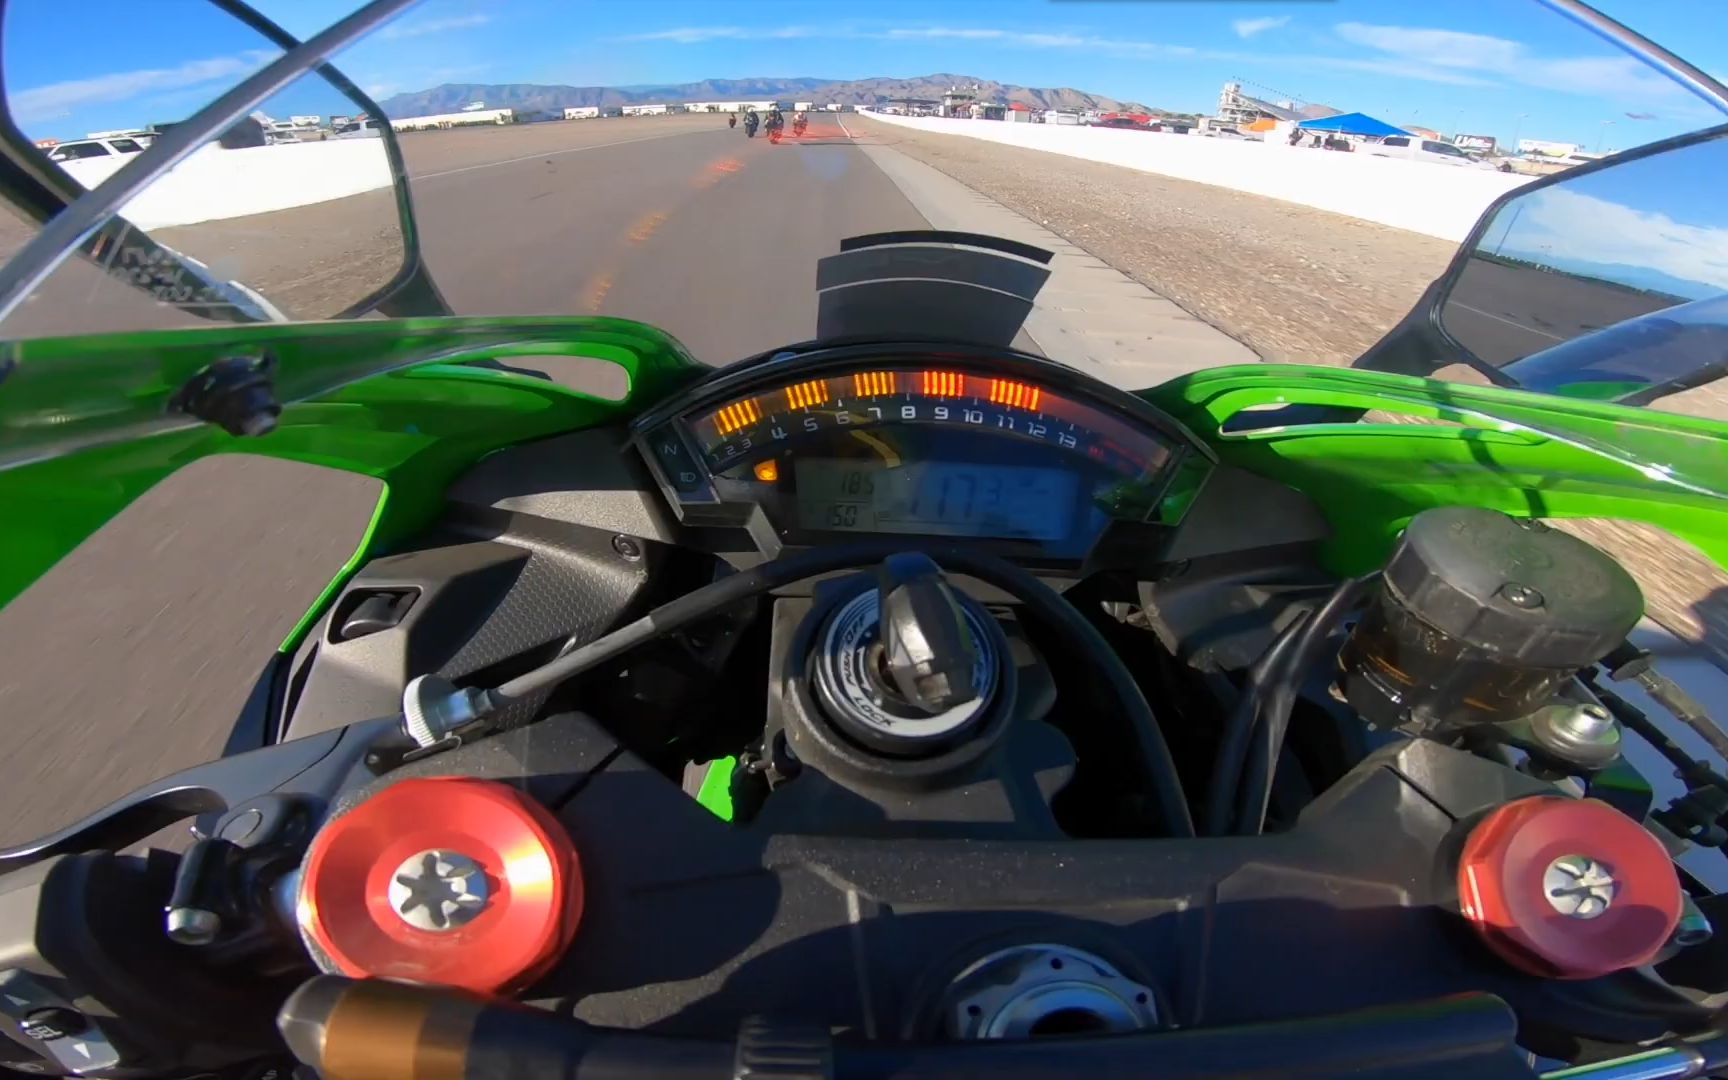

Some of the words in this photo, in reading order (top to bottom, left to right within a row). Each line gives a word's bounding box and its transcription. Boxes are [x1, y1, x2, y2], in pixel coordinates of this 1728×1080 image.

[725, 444, 736, 456] 2
[742, 438, 752, 449] 3
[771, 426, 788, 440] 4
[803, 417, 818, 432] 5
[835, 410, 849, 425] 6
[867, 407, 882, 420] 7
[901, 405, 916, 420] 8
[934, 406, 949, 420] 9
[962, 408, 984, 424] 10
[996, 413, 1015, 429] 11
[1027, 421, 1047, 439] 12
[1058, 431, 1077, 449] 13
[663, 443, 677, 456] N
[853, 695, 896, 727] LOCK
[24, 1025, 63, 1040] SEL
